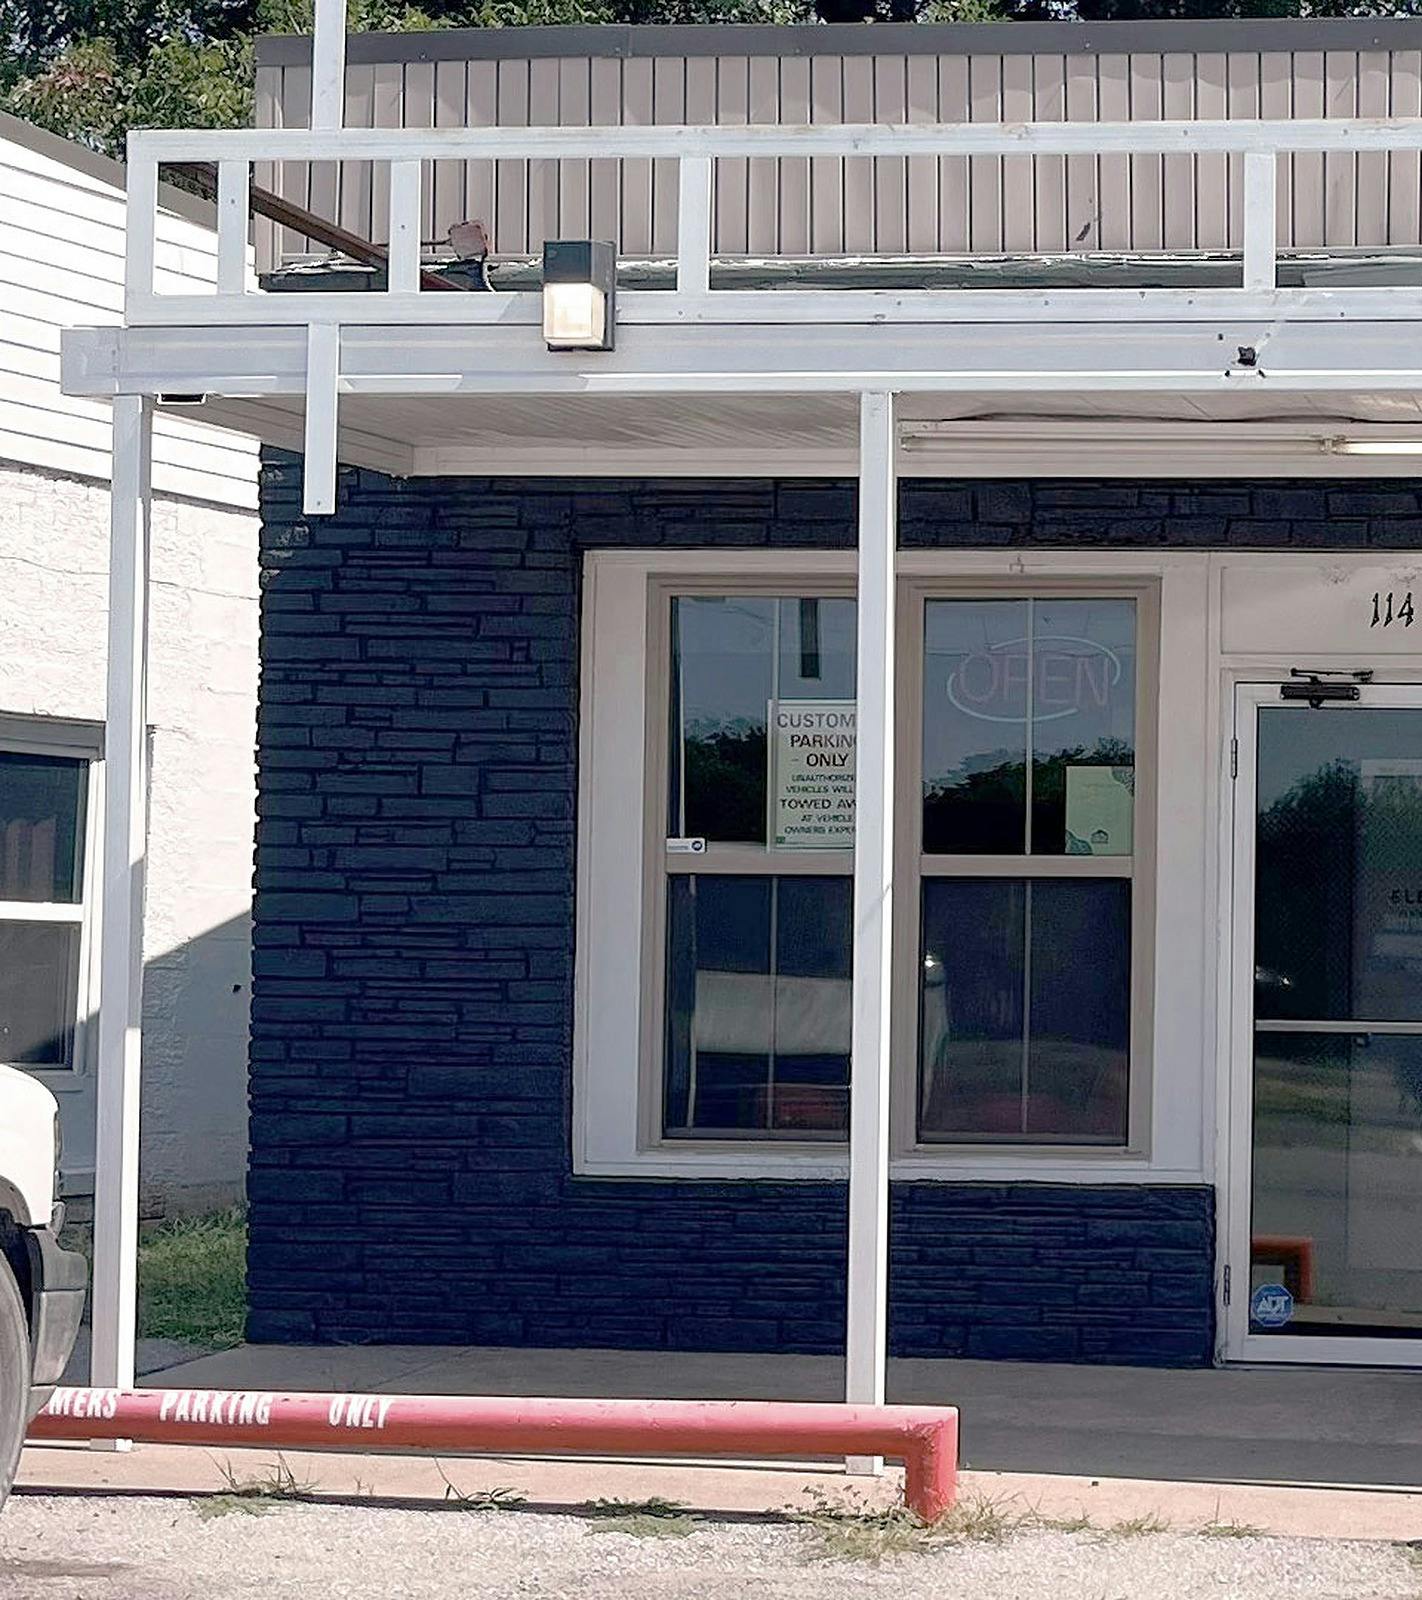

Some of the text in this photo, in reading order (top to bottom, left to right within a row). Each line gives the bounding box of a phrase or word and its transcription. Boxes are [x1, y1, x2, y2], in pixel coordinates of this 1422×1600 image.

[1369, 591, 1414, 627] 114
[957, 651, 1112, 706] OPEN
[777, 713, 857, 728] CUSTOM
[790, 734, 857, 748] PARKIN
[806, 753, 849, 767] ONLY
[786, 785, 829, 793] VEHICLES
[780, 799, 856, 809] TOWED AW
[1257, 1295, 1289, 1314] ADT
[40, 1388, 394, 1429] MERS PARKING ONLY
